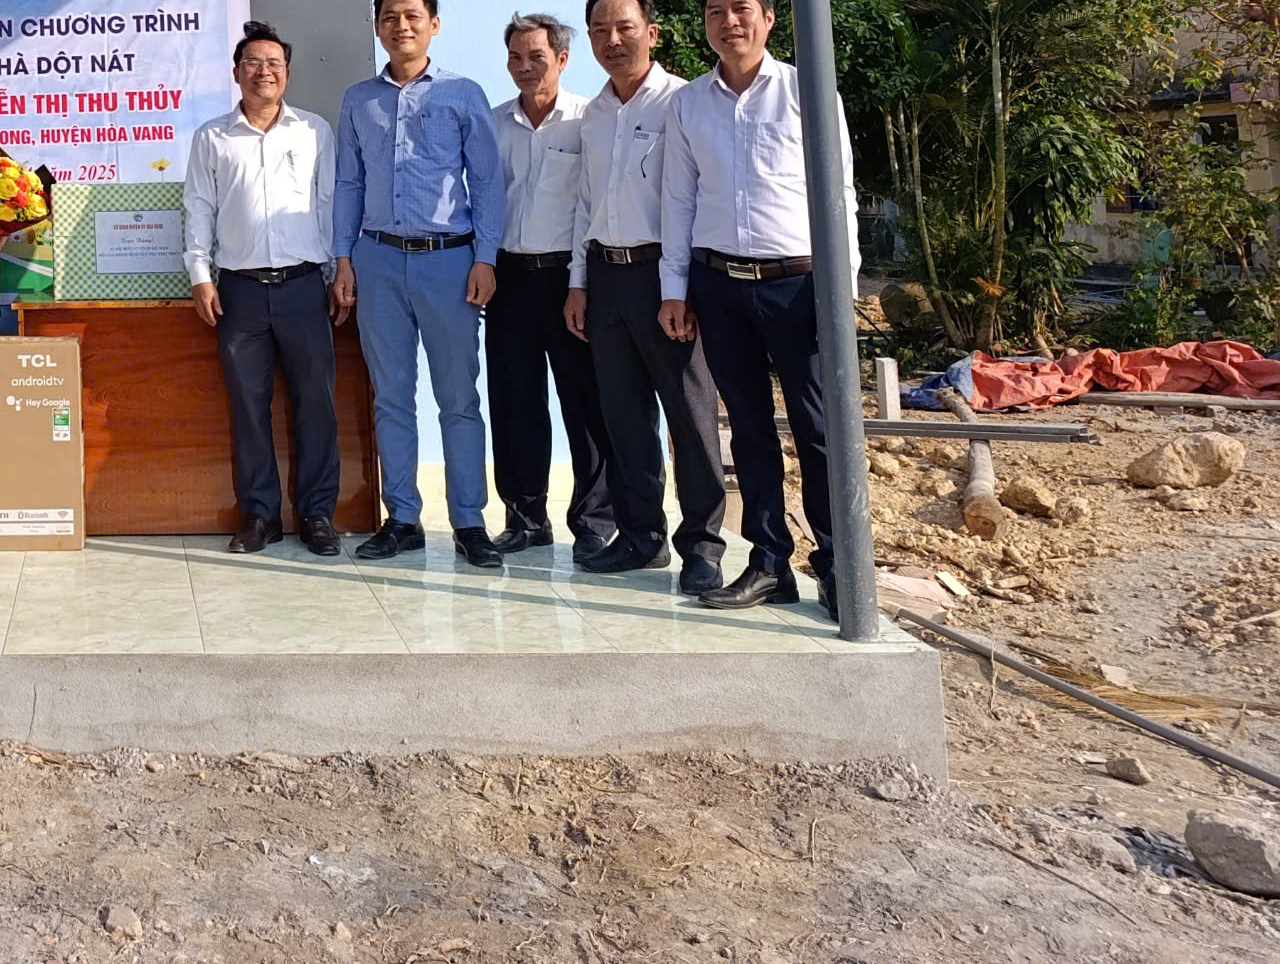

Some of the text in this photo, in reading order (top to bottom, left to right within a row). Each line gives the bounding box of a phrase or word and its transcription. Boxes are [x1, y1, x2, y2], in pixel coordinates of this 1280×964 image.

[20, 15, 126, 37] CHƯƠNG
[132, 8, 200, 33] TRÌNH
[37, 51, 83, 79] DỘT
[91, 49, 135, 73] NÁT
[33, 93, 69, 117] THỊ
[74, 91, 118, 113] THU
[125, 84, 183, 111] THỦY
[41, 125, 92, 146] HUYỆN
[97, 123, 128, 142] HÒA
[132, 125, 174, 141] VANG
[50, 164, 117, 181] ăm 2025
[17, 354, 57, 368] TCL
[11, 375, 64, 386] androidtv
[25, 398, 70, 408] Hey Google
